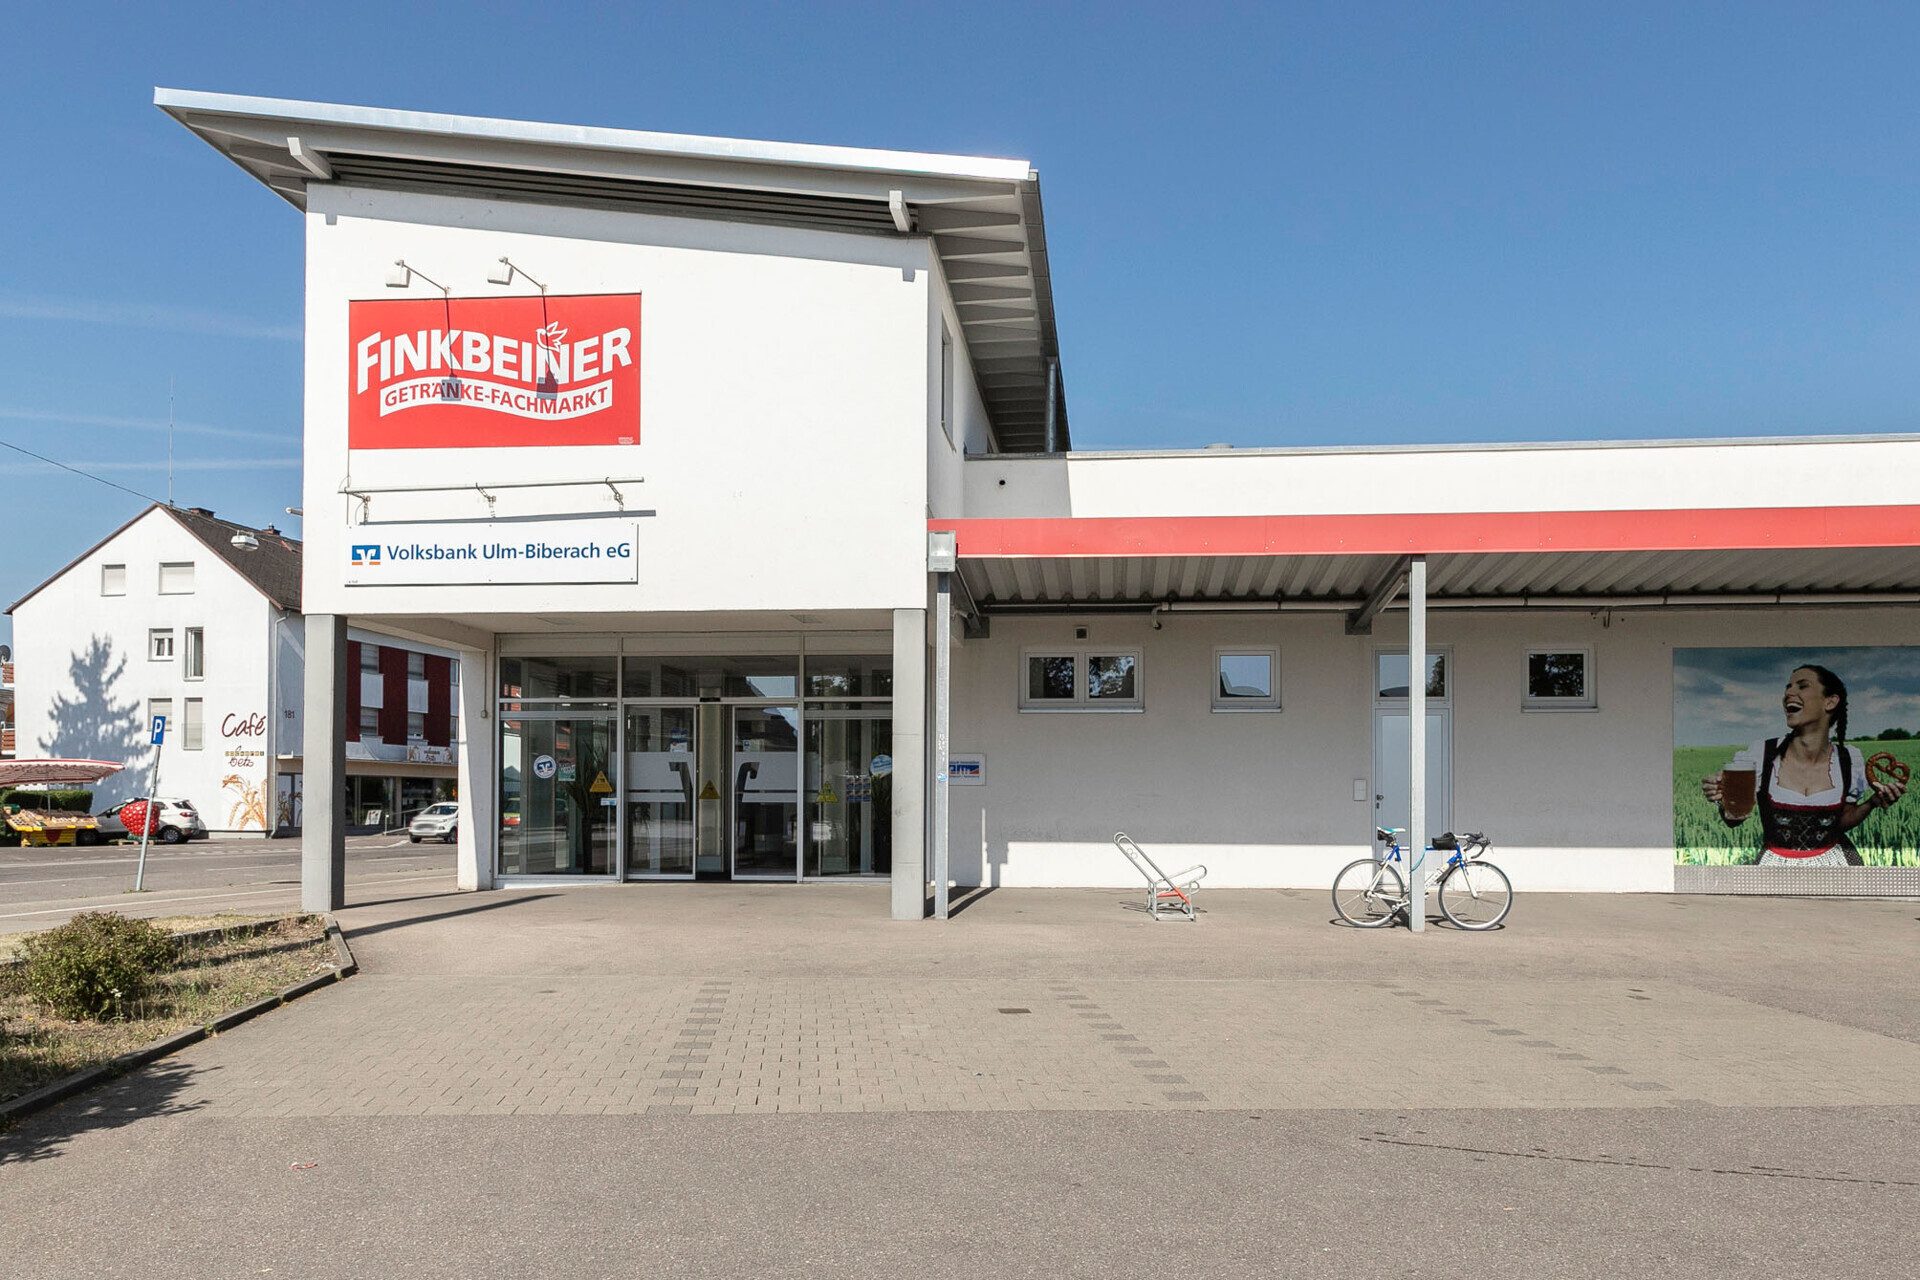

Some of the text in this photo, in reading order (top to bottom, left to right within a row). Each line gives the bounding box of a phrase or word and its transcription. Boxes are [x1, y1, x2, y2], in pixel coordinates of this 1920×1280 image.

[357, 327, 632, 395] FINKBEINER
[384, 380, 609, 414] GETRÄNKE-FACHMARKT
[387, 543, 630, 560] Volksbank Ulm-Biberach eG
[221, 712, 267, 738] Café
[284, 709, 295, 719] 181
[153, 718, 163, 741] P
